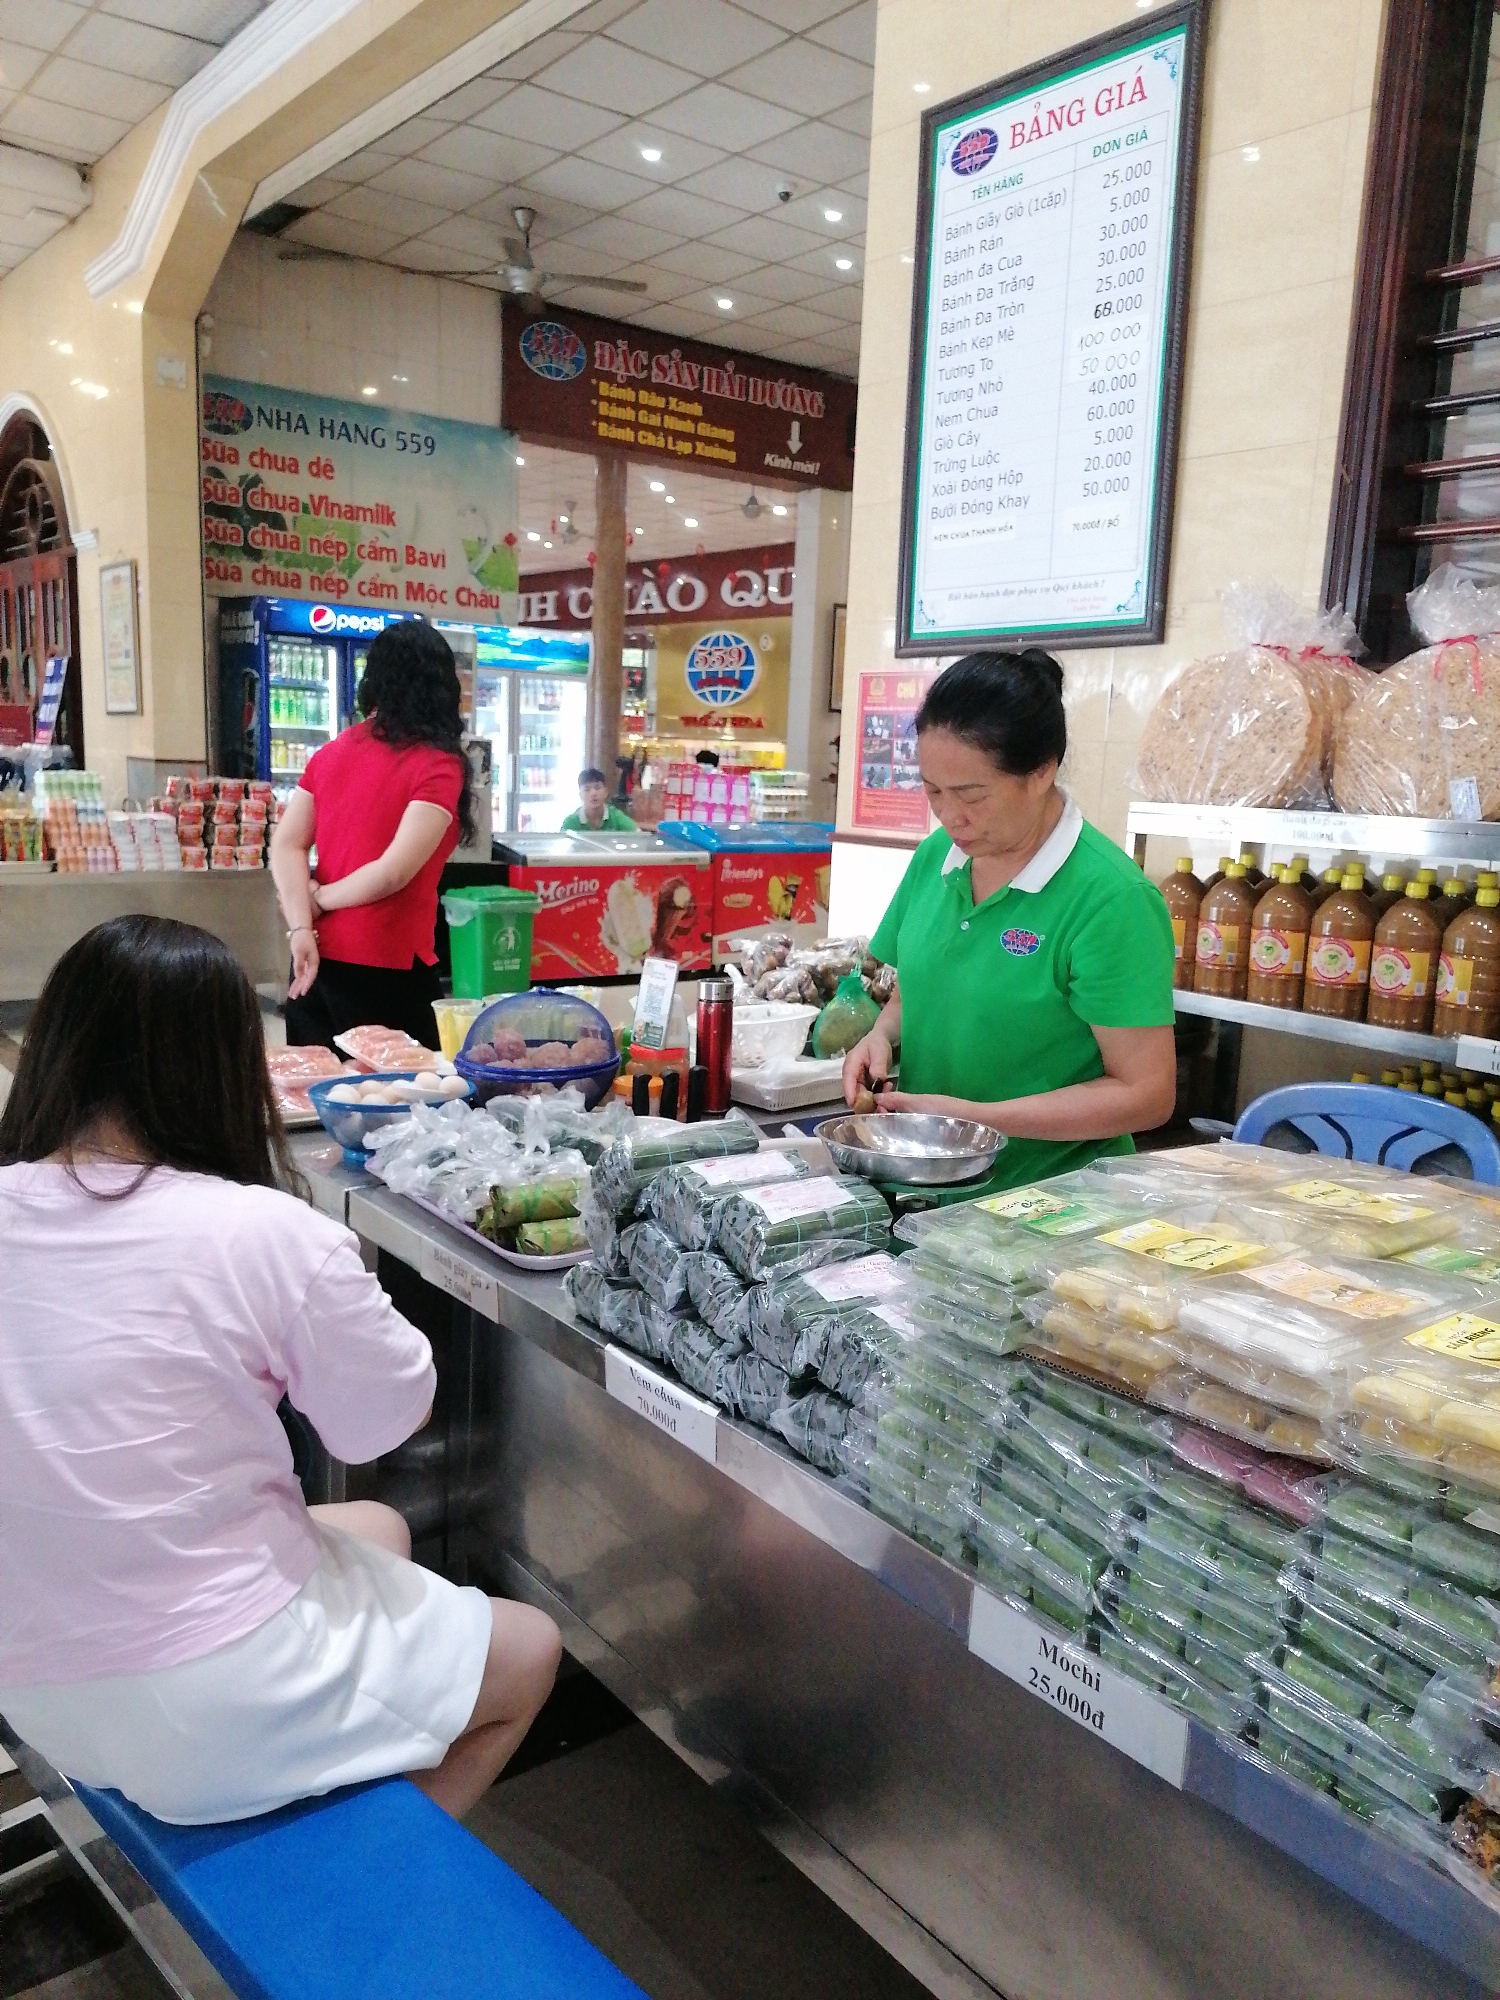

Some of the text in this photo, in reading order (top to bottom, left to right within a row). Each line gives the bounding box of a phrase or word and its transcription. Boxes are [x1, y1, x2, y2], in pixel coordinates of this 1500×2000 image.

[1009, 65, 1147, 150] BẢNG GIÁ
[972, 172, 1024, 201] TÊN HÀNG
[1102, 160, 1152, 189] 25.000
[1110, 187, 1150, 213] 5.000
[945, 221, 972, 241] Bánh
[1005, 201, 1024, 220] Giò
[1099, 213, 1148, 242] 30.000
[944, 235, 1003, 265] Bánh Rán
[1097, 240, 1146, 268] 30.000
[943, 253, 1023, 289] Bánh đa Cua
[1096, 267, 1145, 294] 25.000
[941, 274, 1035, 312] Bánh Đa Trắng
[940, 300, 1025, 336] Bánh Đa Tròn
[939, 341, 969, 359] Bánh
[996, 328, 1015, 342] Mè
[594, 338, 649, 383] ĐẶC
[651, 349, 699, 391] SẢN
[702, 361, 747, 402] HẢI
[937, 357, 994, 382] Tương To
[599, 382, 636, 402] Bánh
[937, 378, 1004, 406] Tương Nhỏ
[1088, 372, 1137, 396] 40.000
[599, 401, 636, 421] Bánh
[935, 404, 999, 429] Nem Chua
[1087, 398, 1135, 422] 60.000
[396, 431, 436, 456] 559
[598, 421, 635, 442] Bánh
[934, 430, 981, 452] Giò Cây
[1094, 424, 1134, 446] 5.000
[249, 447, 300, 475] chua
[308, 456, 335, 480] dê
[933, 450, 1001, 474] Trứng Luộc
[1083, 450, 1132, 472] 20.000
[931, 469, 1024, 498] Xoài Đóng Hộp
[1082, 476, 1130, 498] 50.000
[248, 485, 300, 513] chua
[308, 494, 397, 527] Vinamilk
[931, 493, 1030, 520] Bưởi Đóng Khay
[250, 522, 301, 550] chua
[309, 533, 349, 561] nếp
[356, 536, 398, 564] cẩm
[251, 560, 302, 589] chua
[309, 570, 349, 599] nếp
[357, 572, 398, 600] cẩm
[405, 579, 449, 609] Mộc
[455, 586, 501, 611] Châu
[567, 567, 708, 621] CÀO
[336, 613, 385, 633] pepsi
[694, 646, 747, 670] 559
[535, 876, 600, 902] Merino
[628, 1365, 682, 1412] Nem chua
[637, 1396, 677, 1433] 70.000đ
[1038, 1637, 1101, 1693] Mochi
[1028, 1667, 1105, 1731] 25.000đ
